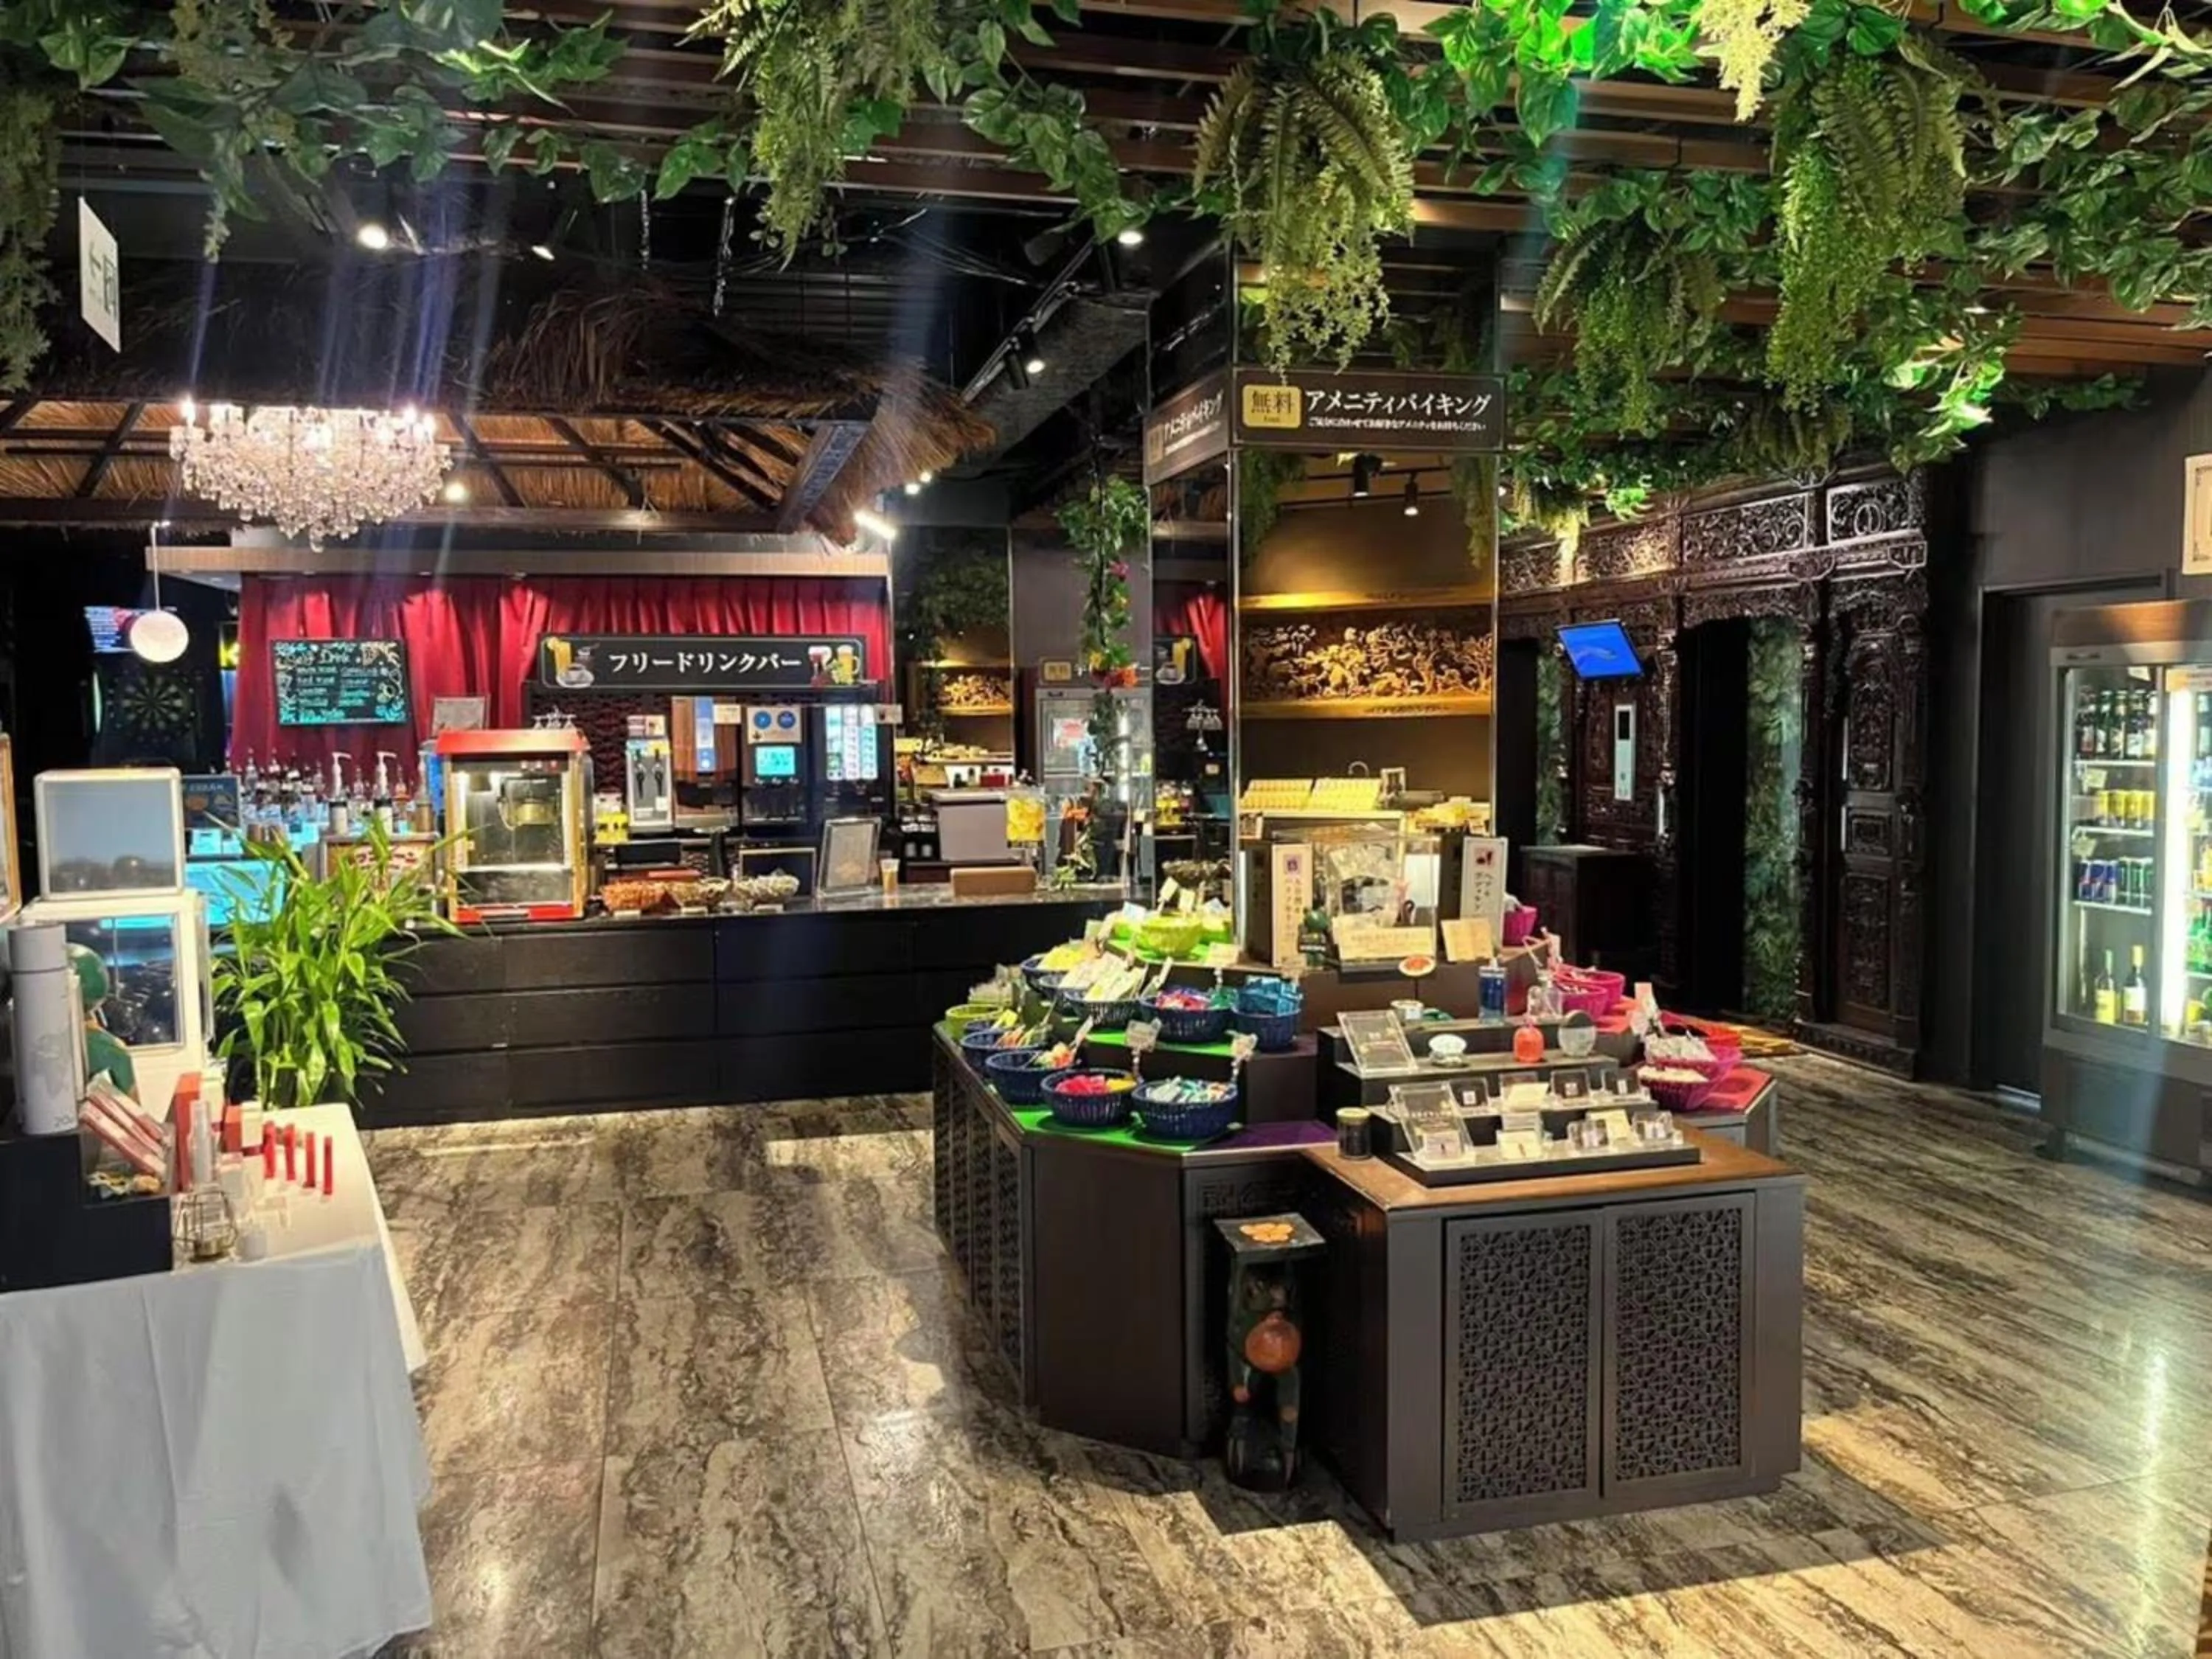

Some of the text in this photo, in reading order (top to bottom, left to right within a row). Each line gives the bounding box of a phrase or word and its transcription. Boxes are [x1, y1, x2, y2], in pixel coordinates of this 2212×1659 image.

[1251, 390, 1293, 414] 無料
[1305, 389, 1492, 417] アメニティバイキング
[608, 651, 802, 674] フリードリンクバー
